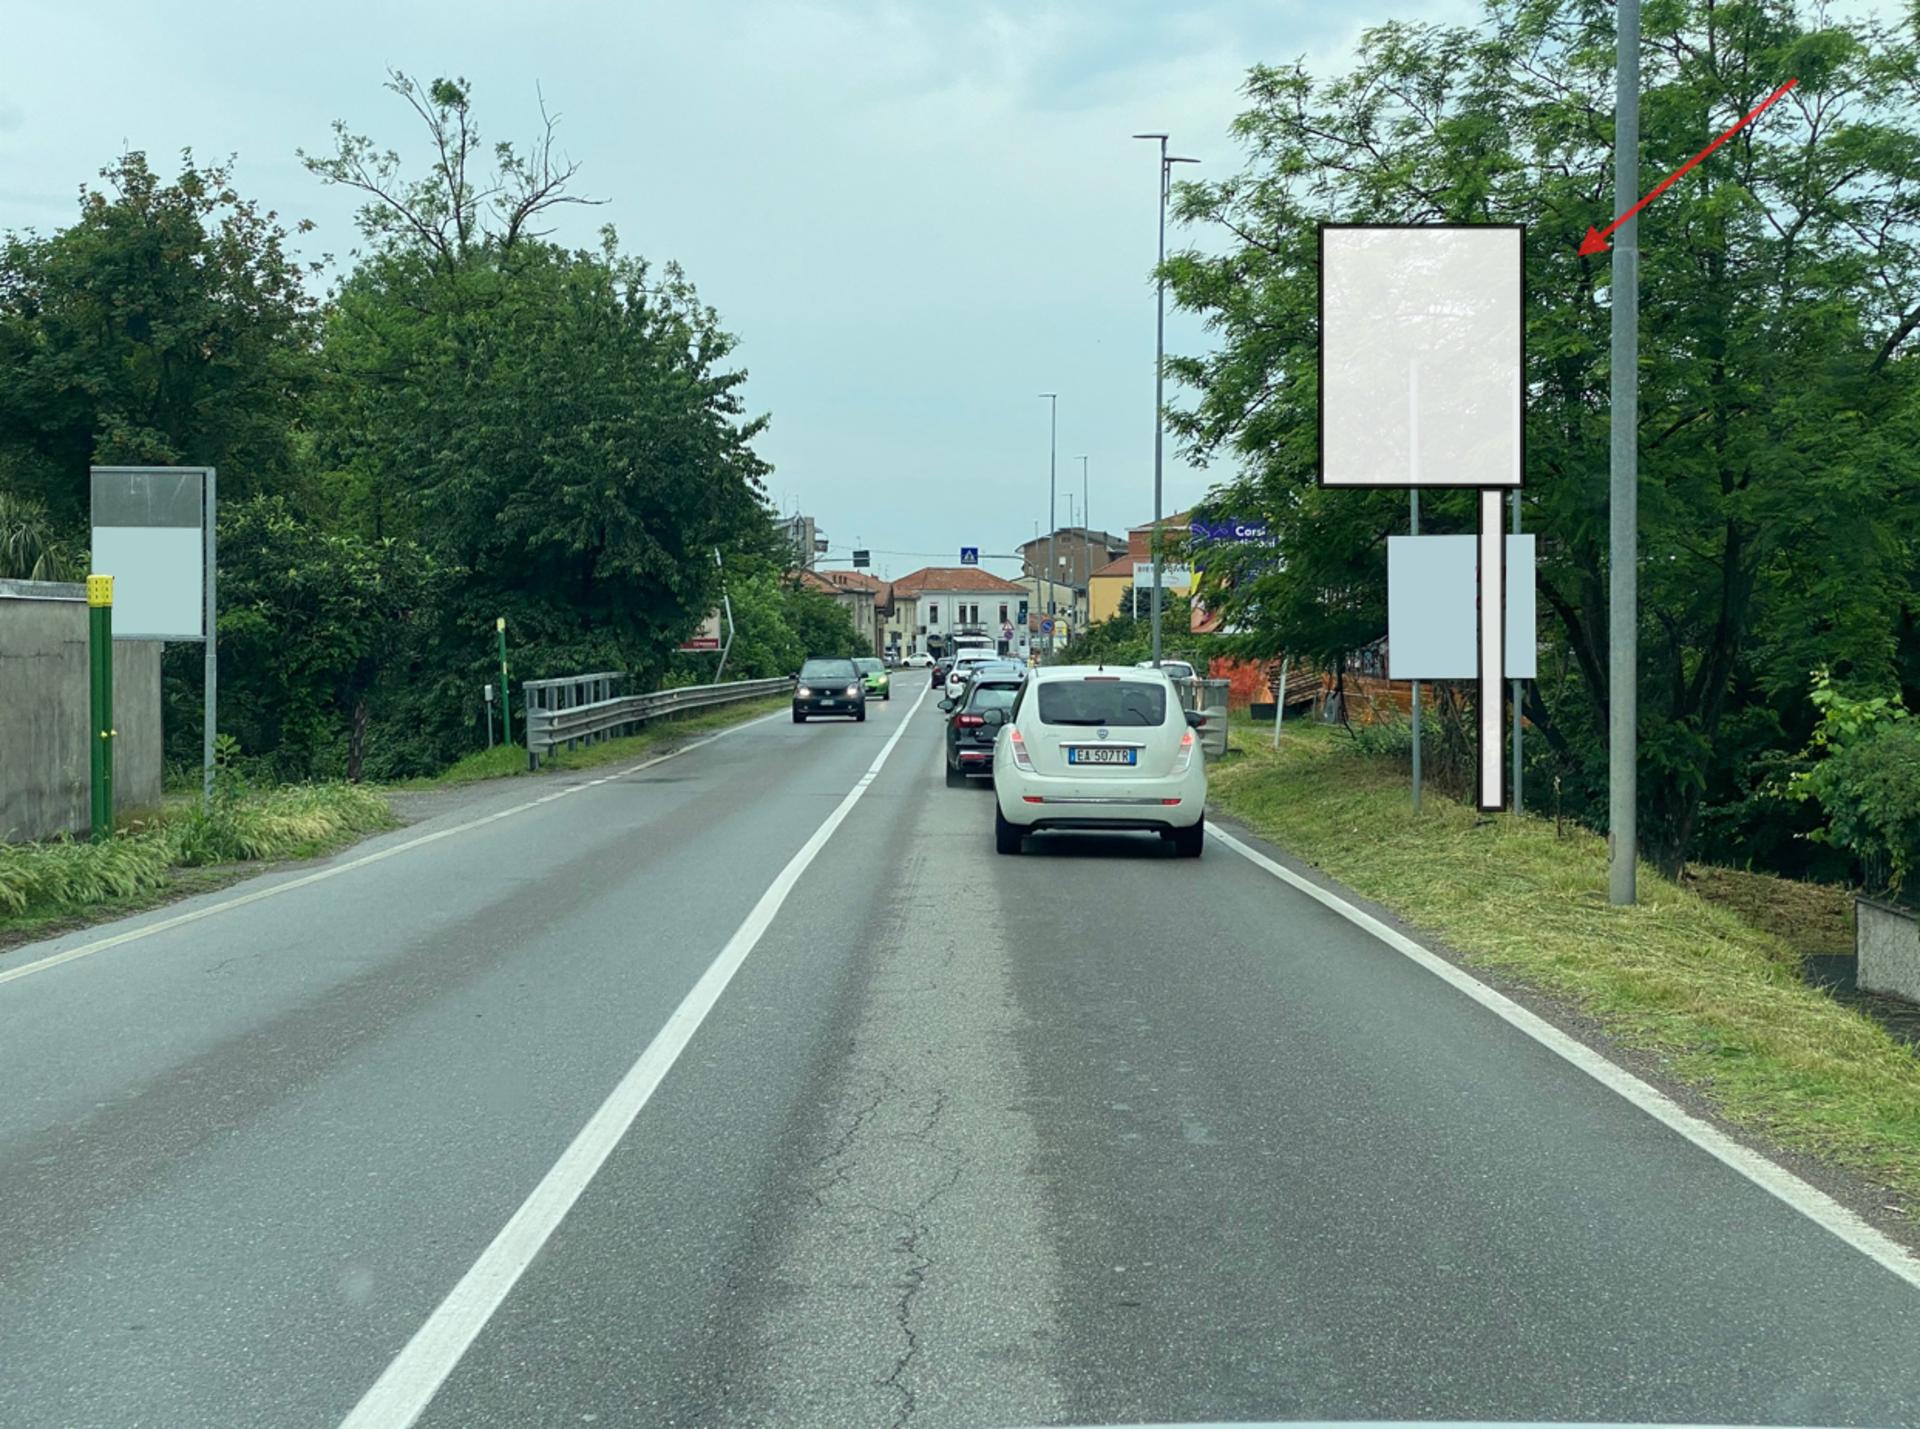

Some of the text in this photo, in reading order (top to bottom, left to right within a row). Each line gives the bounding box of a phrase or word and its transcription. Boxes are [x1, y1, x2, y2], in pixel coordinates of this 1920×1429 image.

[1235, 526, 1266, 537] Corsi
[1077, 750, 1129, 761] EA 507TR
